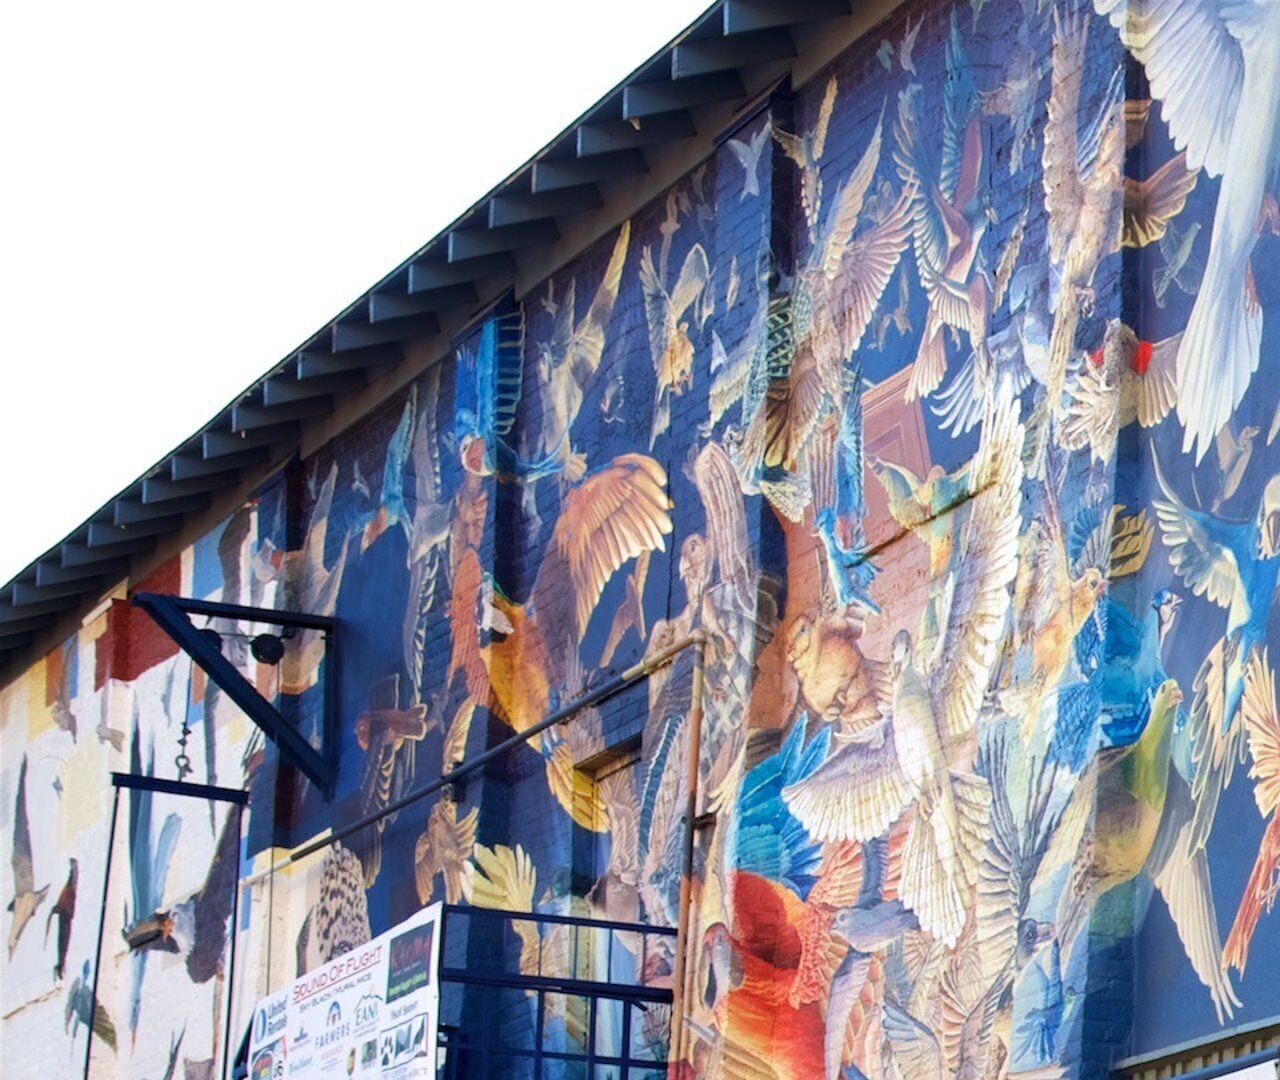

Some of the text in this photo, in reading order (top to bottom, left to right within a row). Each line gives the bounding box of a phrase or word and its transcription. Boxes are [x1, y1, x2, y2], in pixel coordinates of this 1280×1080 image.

[293, 945, 383, 1003] SOUND OF FLIGHT
[314, 1022, 351, 1050] FARMERS
